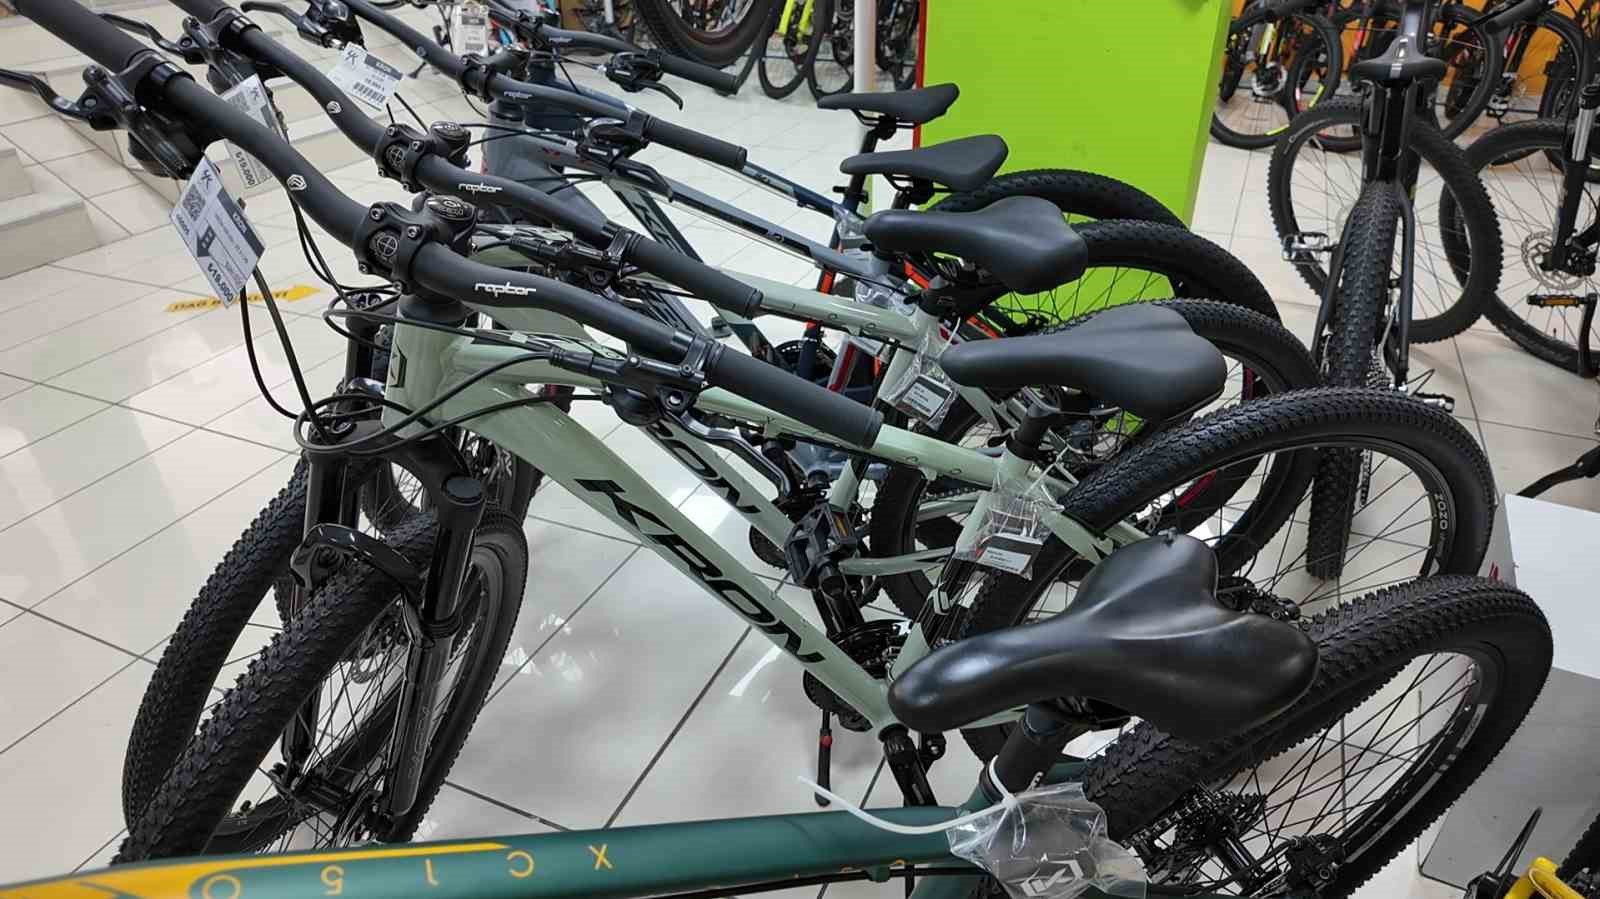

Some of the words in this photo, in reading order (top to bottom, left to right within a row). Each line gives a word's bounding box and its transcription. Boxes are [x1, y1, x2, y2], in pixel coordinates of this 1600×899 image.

[458, 182, 503, 197] raptor
[474, 281, 537, 298] raptor
[573, 478, 826, 664] KRON
